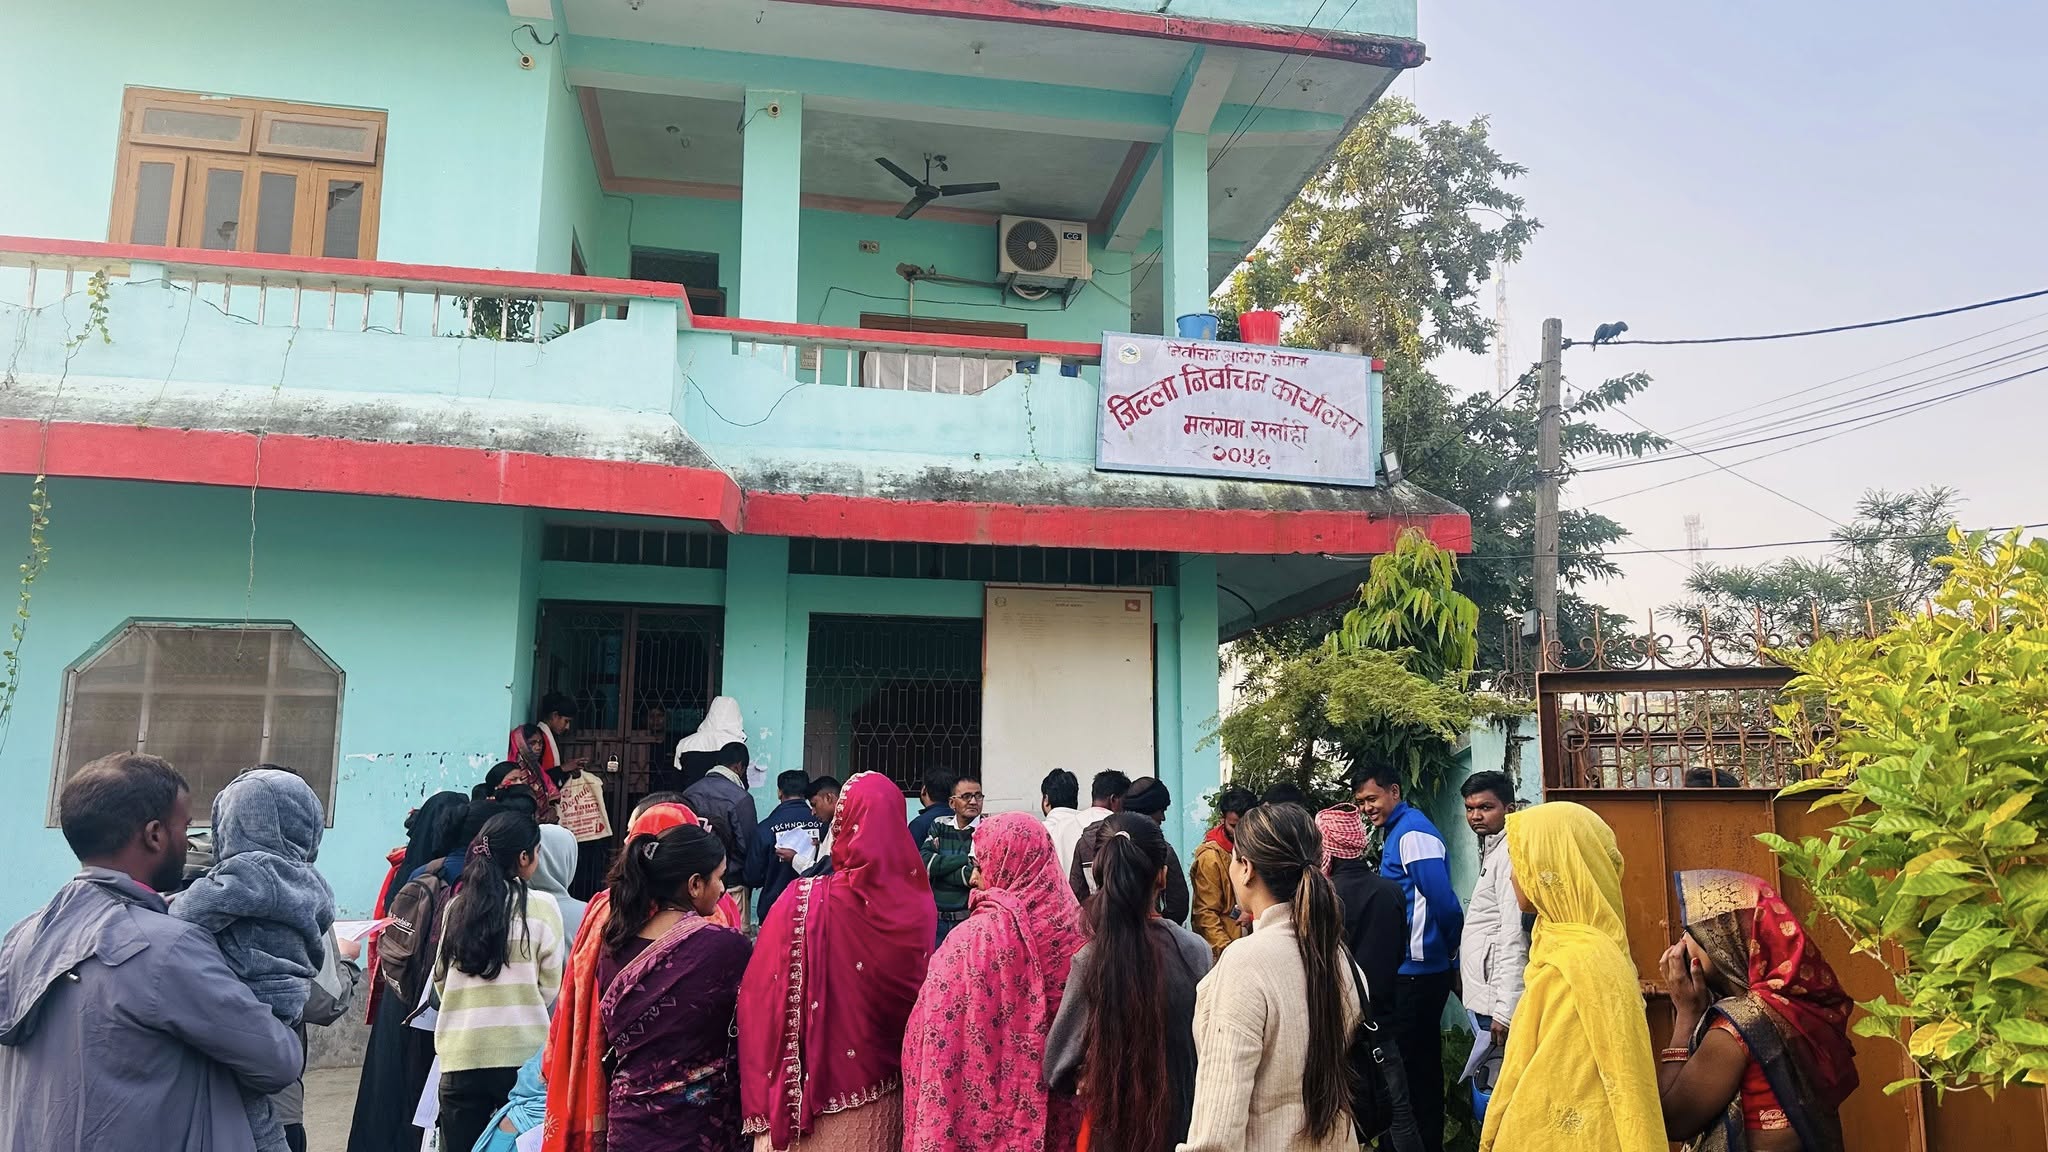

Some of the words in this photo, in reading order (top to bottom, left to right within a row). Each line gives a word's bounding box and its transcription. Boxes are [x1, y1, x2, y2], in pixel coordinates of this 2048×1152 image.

[1107, 374, 1179, 431] जिल्ला
[1179, 363, 1271, 396] निर्वाचन
[1272, 377, 1364, 440] कार्यालय
[1251, 417, 1309, 450] सर्लाही
[770, 821, 823, 832] TECHNOLOGY
